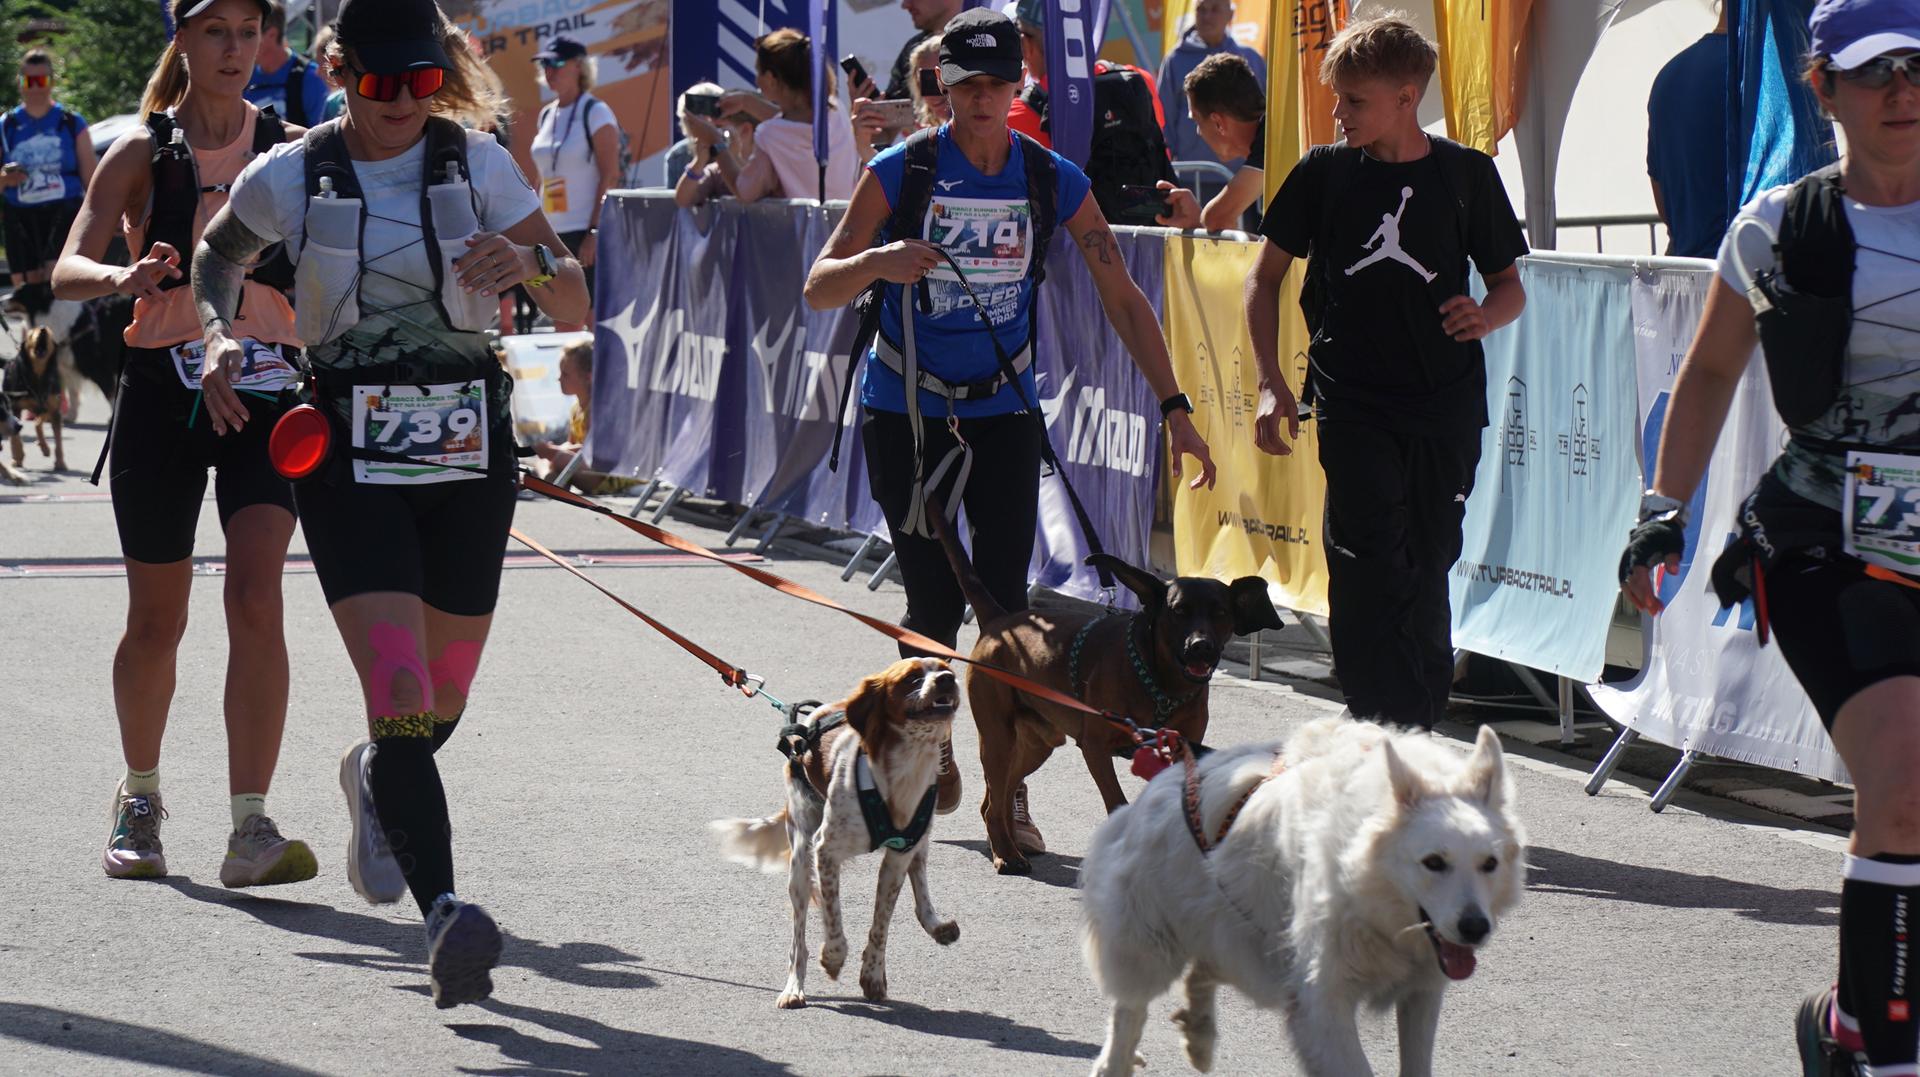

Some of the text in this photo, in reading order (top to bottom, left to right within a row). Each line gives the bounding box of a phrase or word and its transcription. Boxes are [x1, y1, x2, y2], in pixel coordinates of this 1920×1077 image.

[515, 12, 596, 45] TRAIL
[938, 218, 1019, 248] 714
[990, 311, 1017, 326] TRAIL
[371, 408, 478, 443] 739
[132, 798, 149, 817] 42
